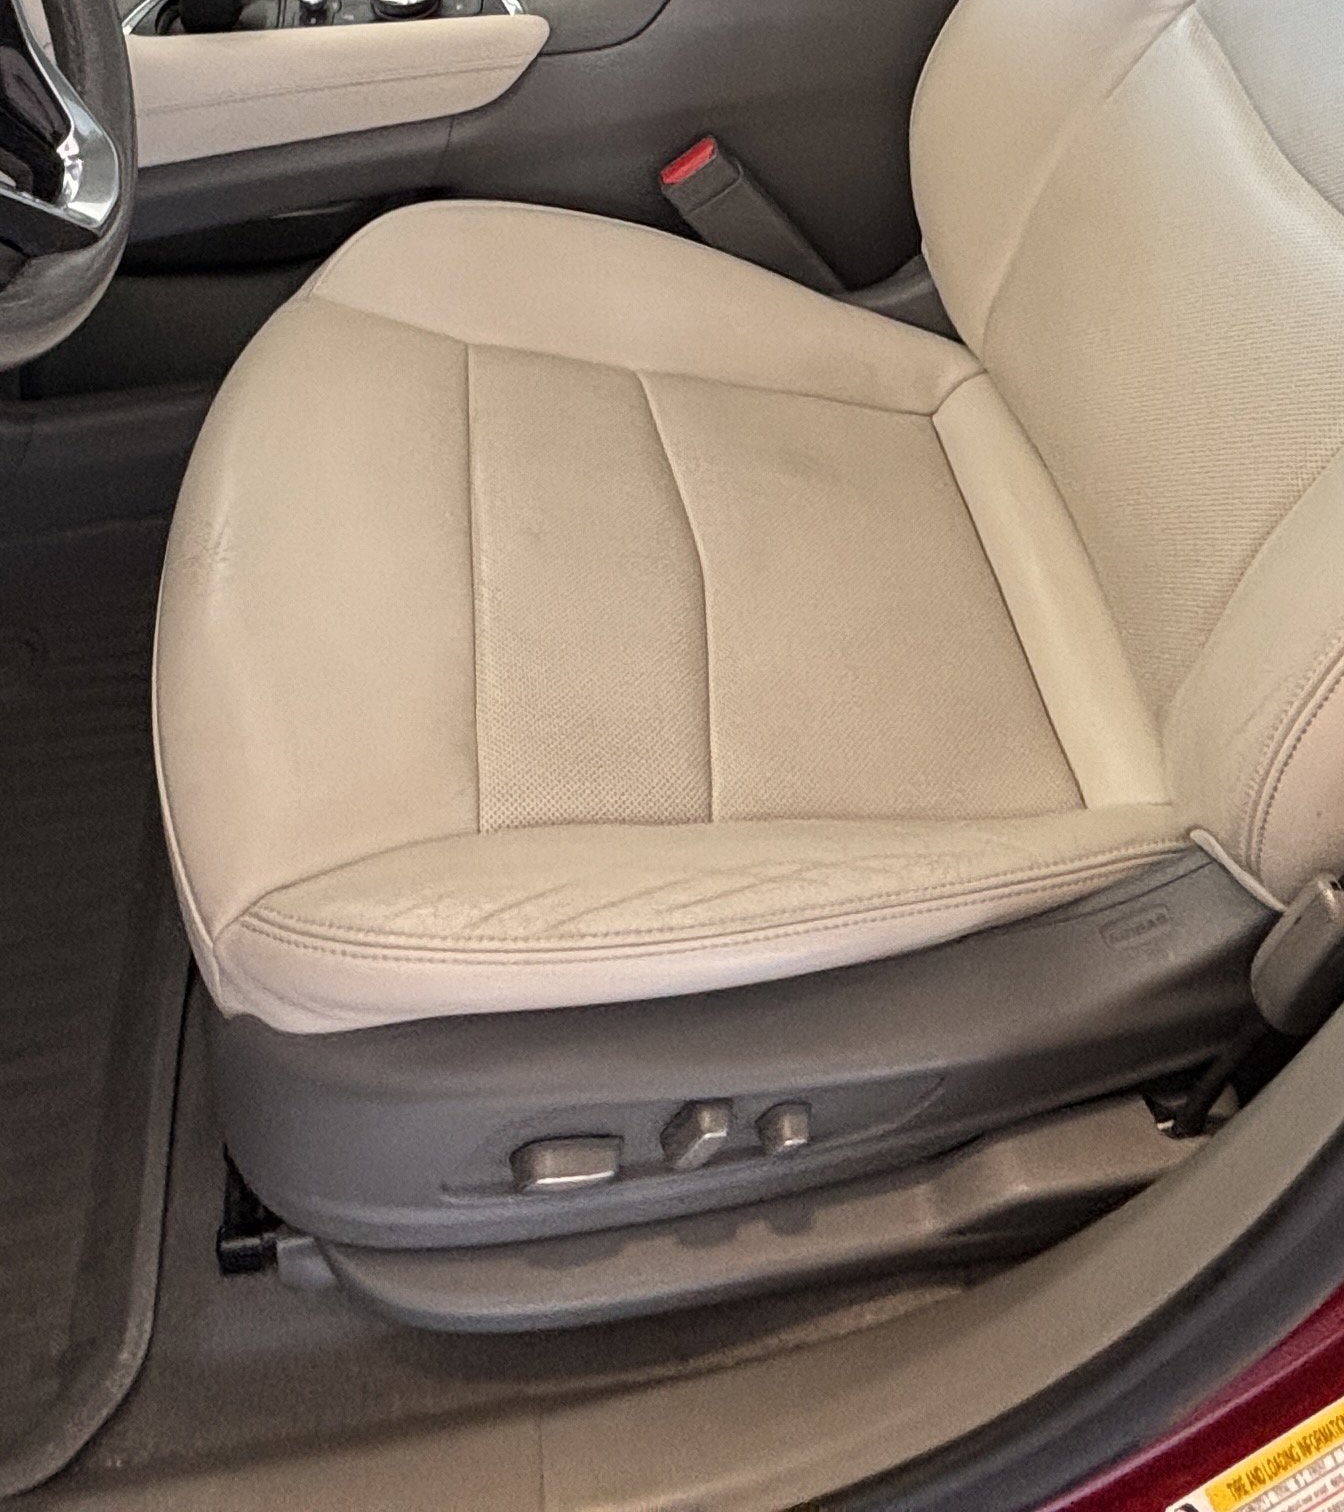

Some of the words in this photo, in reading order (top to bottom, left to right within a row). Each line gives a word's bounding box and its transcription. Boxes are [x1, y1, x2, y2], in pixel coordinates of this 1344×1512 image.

[1226, 1474, 1250, 1502] TIRE
[1245, 1465, 1267, 1490] AND
[1262, 1443, 1301, 1482] LOADING
